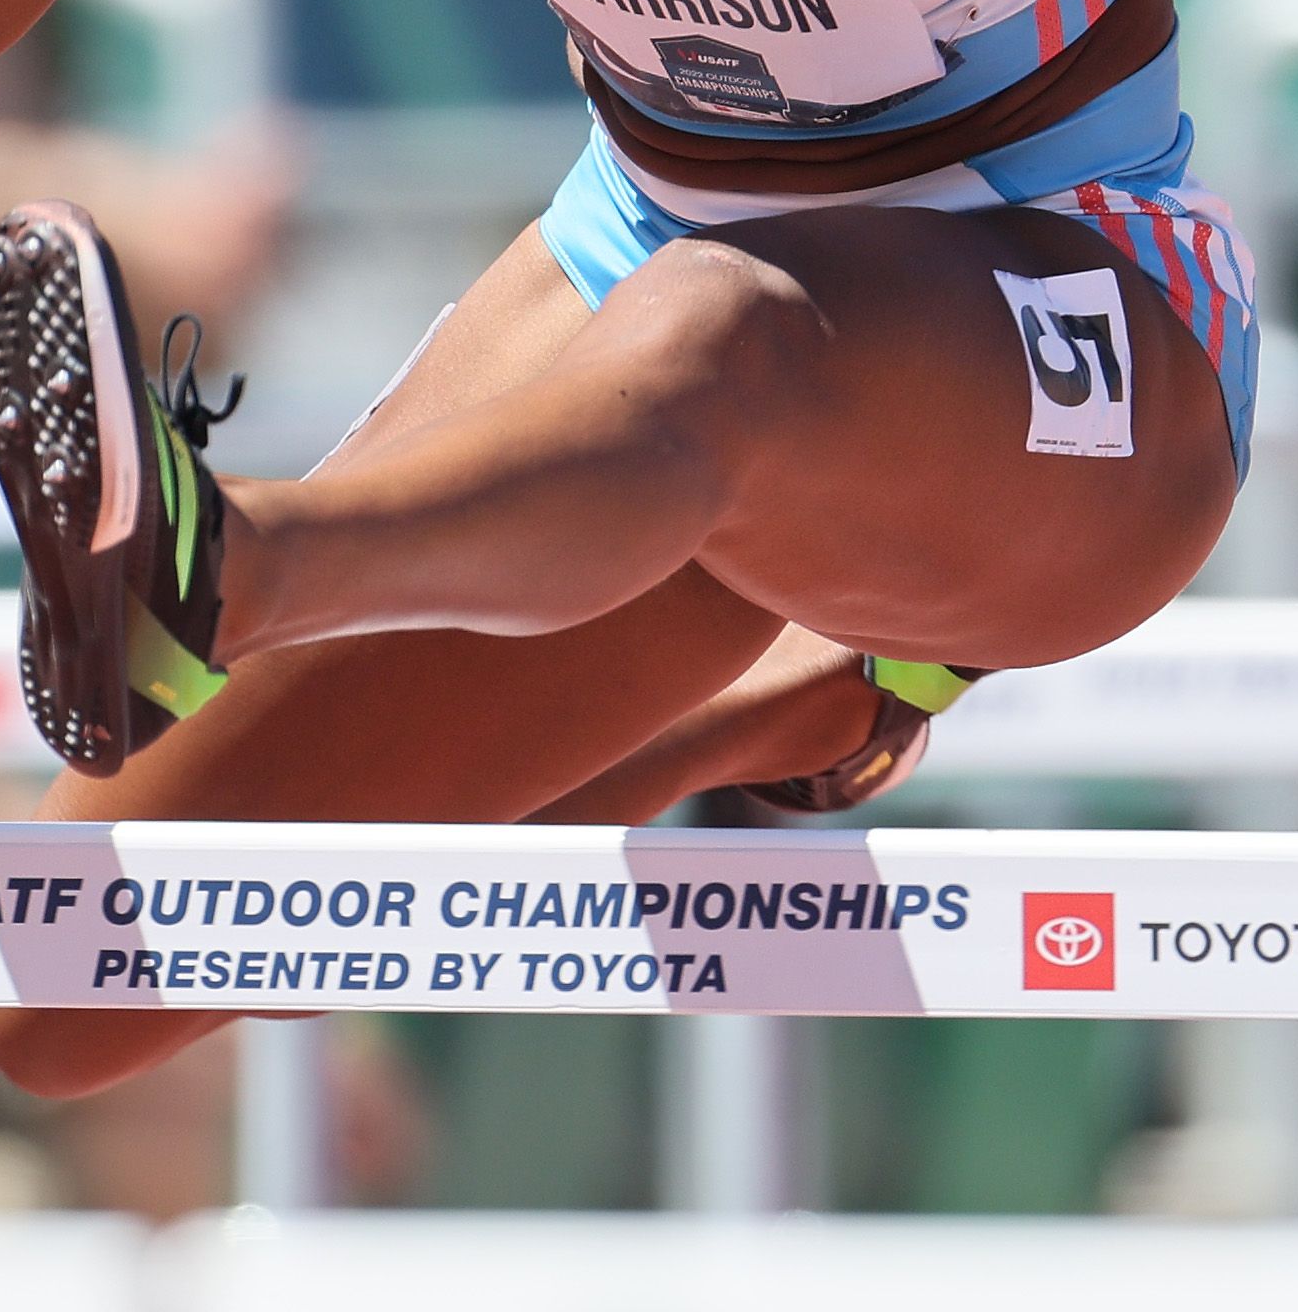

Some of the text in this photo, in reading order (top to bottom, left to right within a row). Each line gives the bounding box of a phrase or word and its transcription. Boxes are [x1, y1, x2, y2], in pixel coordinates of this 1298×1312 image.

[678, 68, 762, 87] 2022 OUTDOOR
[698, 55, 741, 67] USATF
[674, 76, 780, 101] CHAMPIONSHIPS
[1020, 304, 1124, 408] 5
[103, 878, 415, 928] OUTDOOR
[440, 881, 969, 932] CHAMPIONSHIPS
[93, 949, 727, 993] PRESENTED BY TOYOTA
